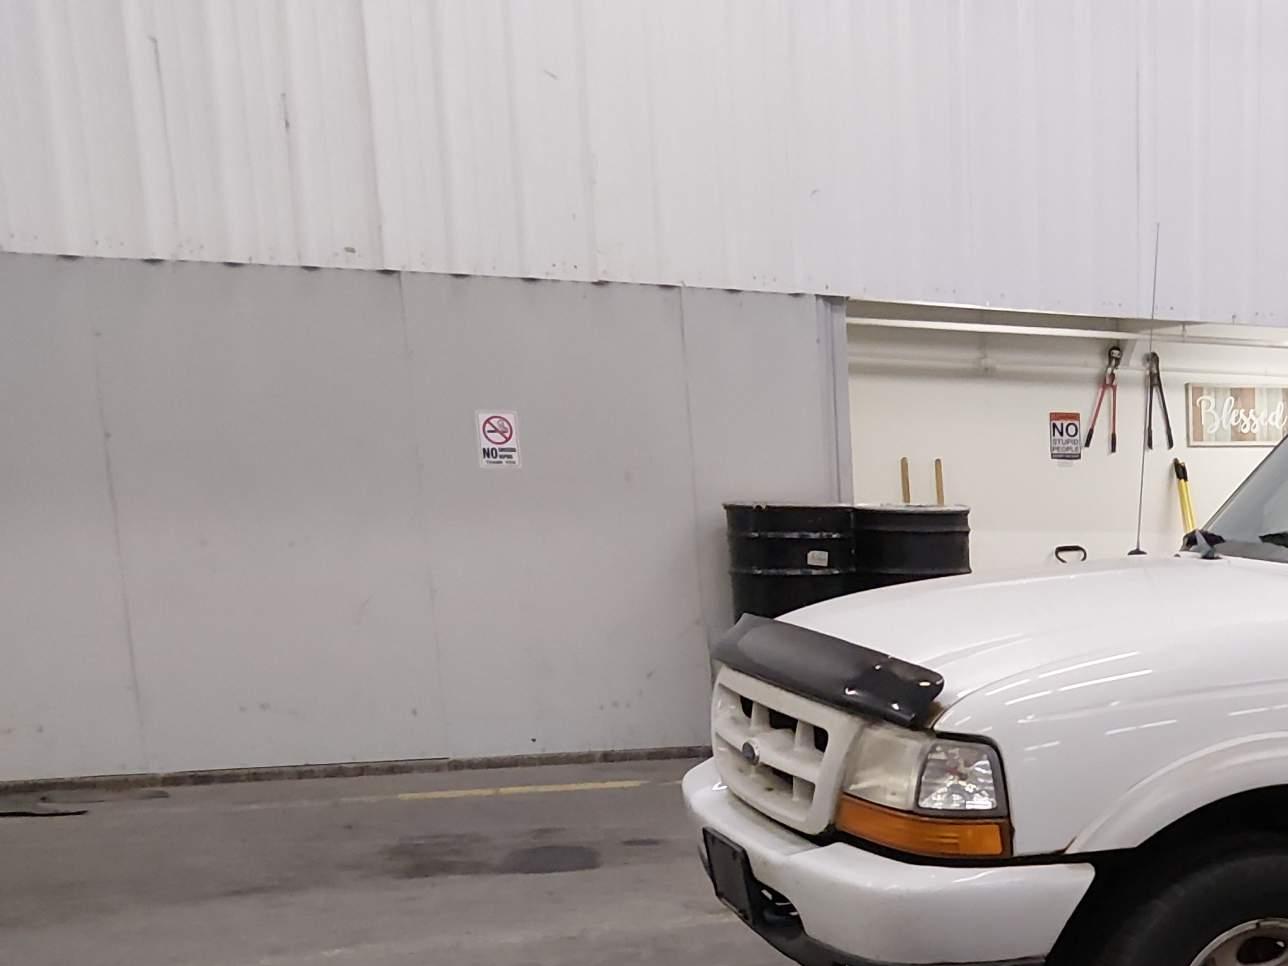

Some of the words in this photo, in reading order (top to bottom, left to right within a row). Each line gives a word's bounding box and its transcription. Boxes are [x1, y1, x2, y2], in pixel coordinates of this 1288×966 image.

[1196, 395, 1287, 433] Blessed
[1052, 422, 1078, 437] NO
[482, 447, 498, 459] NO
